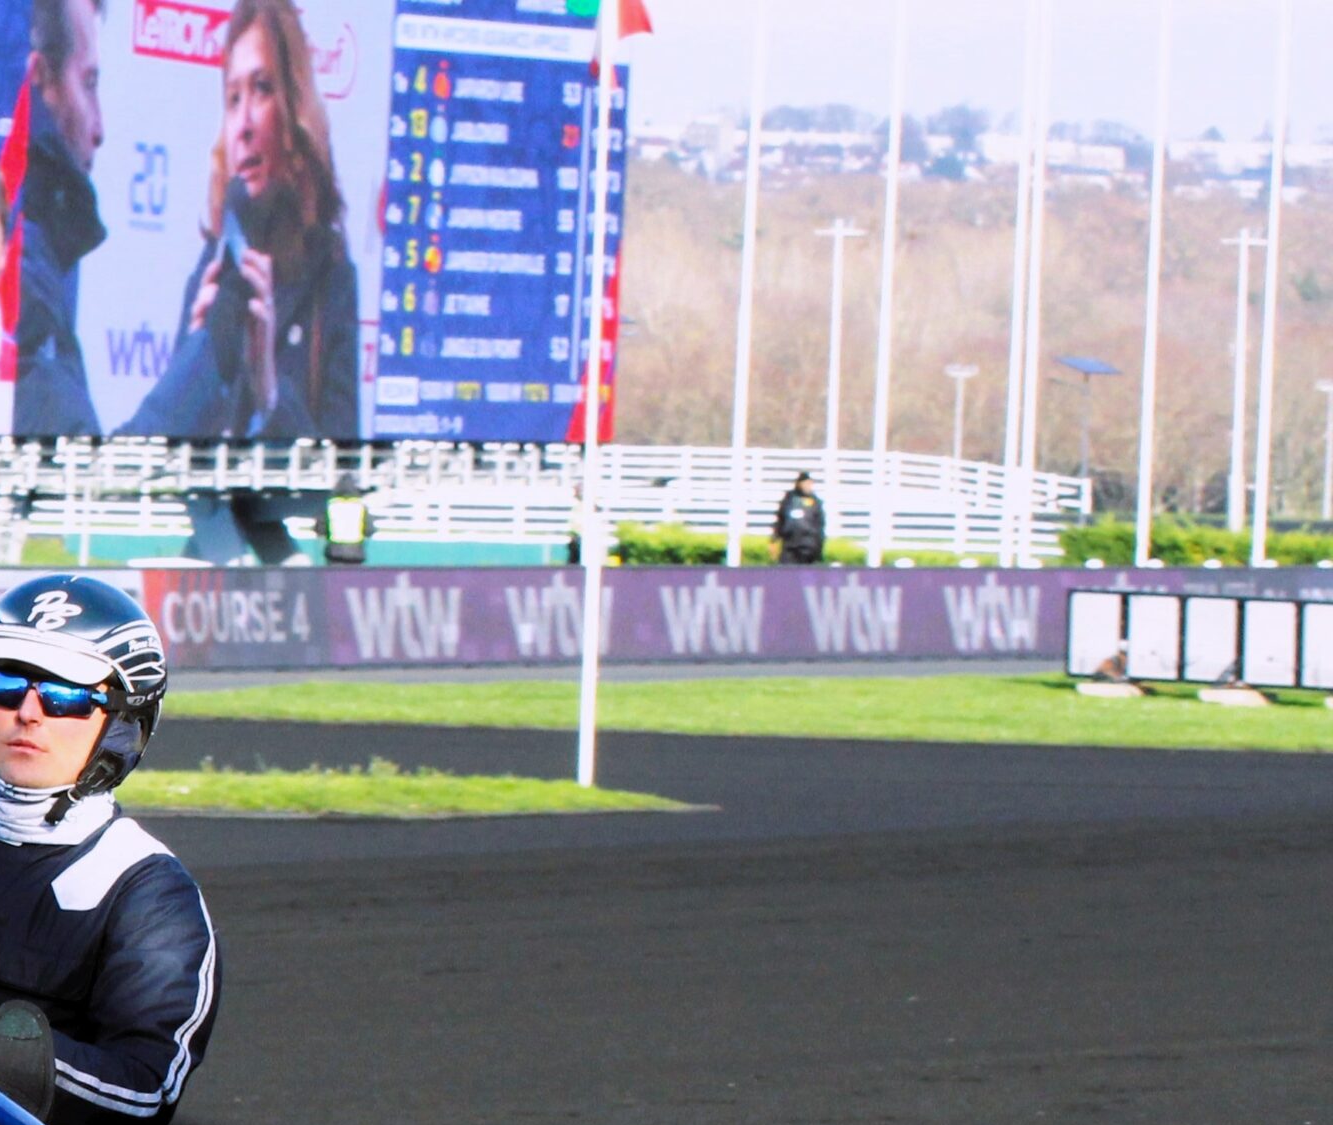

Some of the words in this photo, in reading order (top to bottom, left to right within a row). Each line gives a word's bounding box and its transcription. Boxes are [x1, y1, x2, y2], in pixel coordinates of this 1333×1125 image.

[410, 152, 423, 182] 2
[408, 195, 421, 225] 7
[405, 239, 419, 269] 5
[162, 590, 288, 643] COURSE
[291, 592, 311, 642] 4
